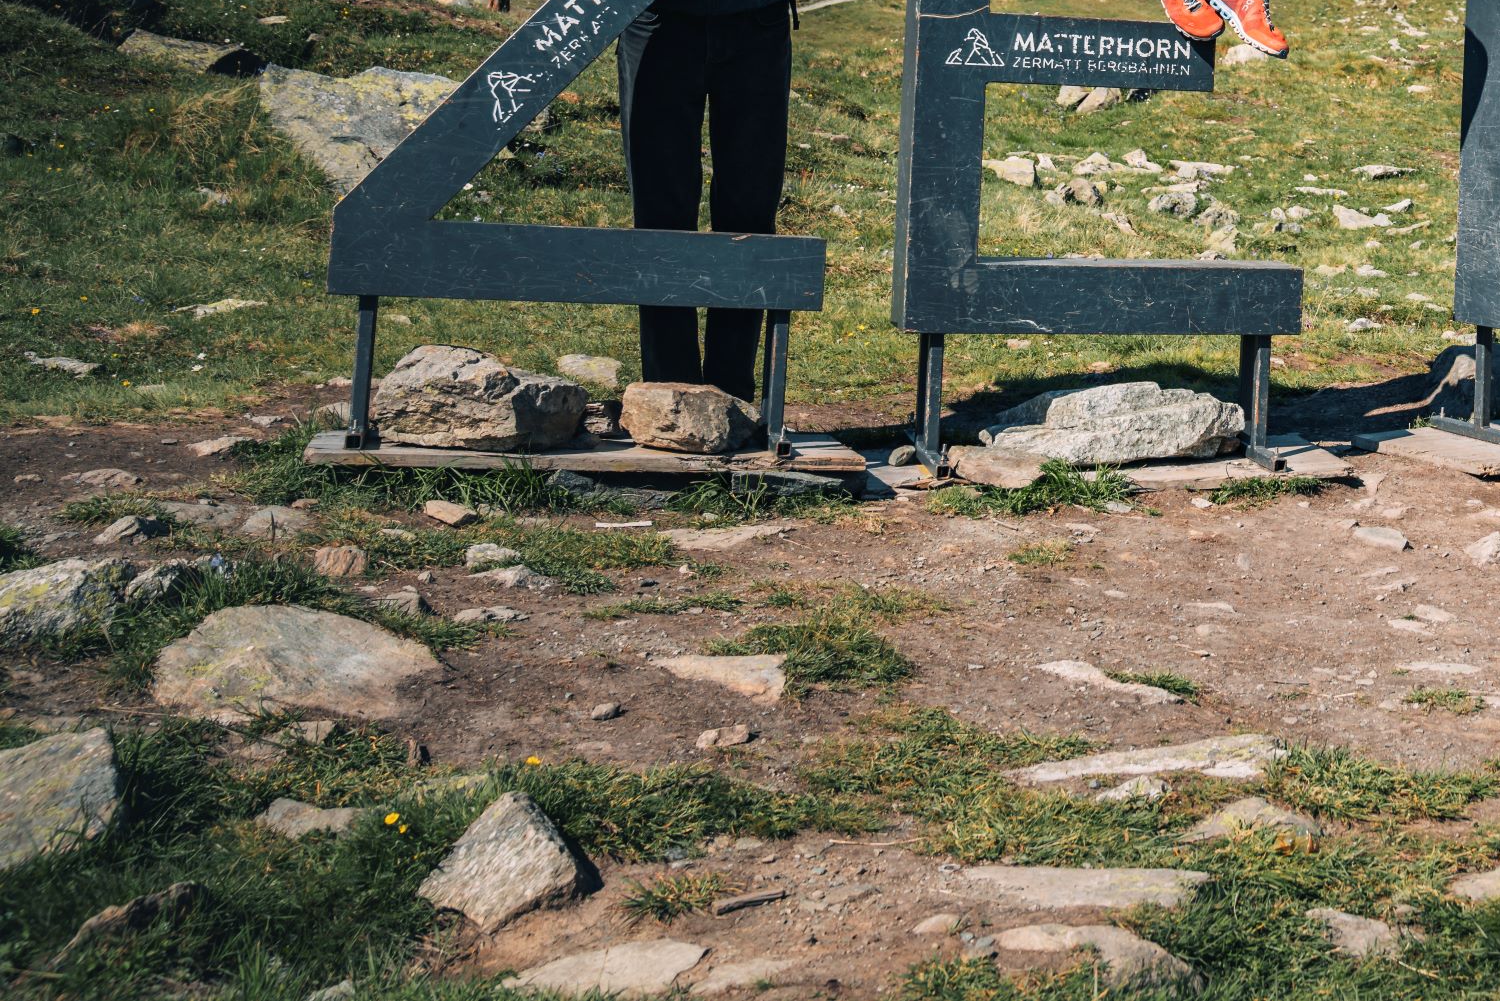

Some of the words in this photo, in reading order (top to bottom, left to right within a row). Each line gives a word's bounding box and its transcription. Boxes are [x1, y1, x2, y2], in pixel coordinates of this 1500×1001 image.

[1013, 31, 1191, 60] MATTERHORN
[1012, 56, 1082, 70] ZERMATT
[1087, 60, 1191, 76] BERGBAHNEN
